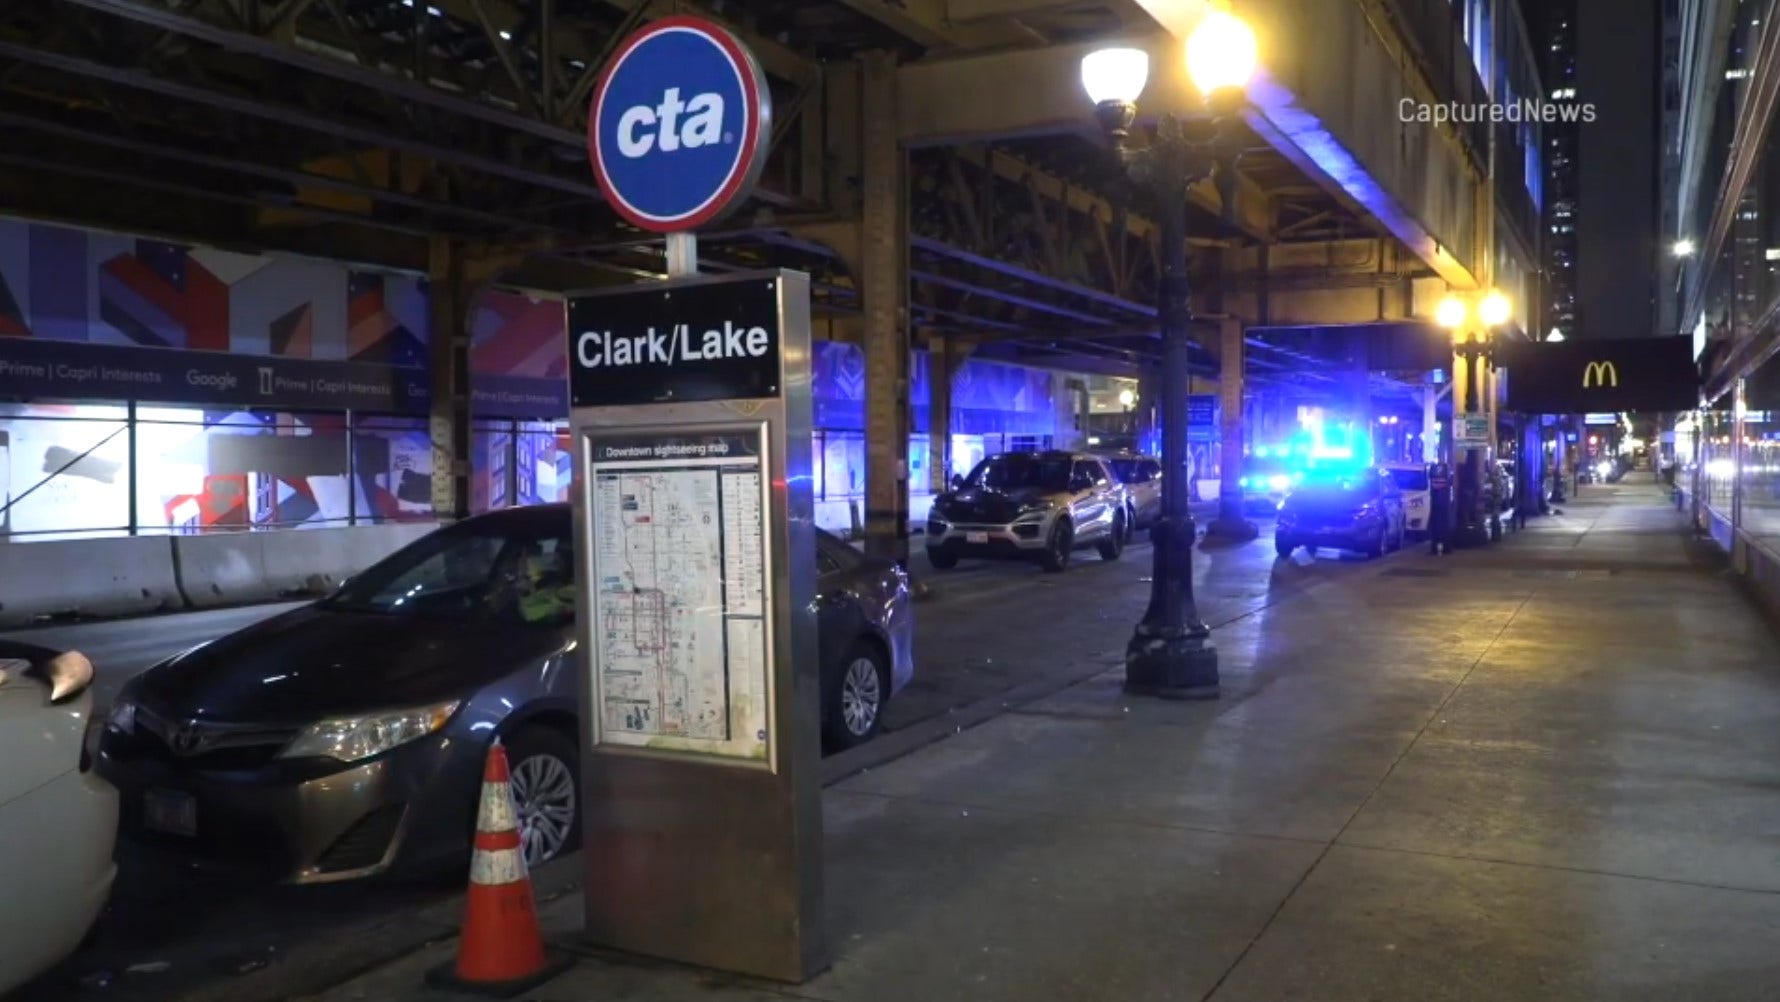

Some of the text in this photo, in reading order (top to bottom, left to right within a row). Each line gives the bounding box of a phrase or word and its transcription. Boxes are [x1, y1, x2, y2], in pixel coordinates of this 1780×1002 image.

[577, 320, 769, 368] Clark/Lake
[0, 360, 45, 377] Prime
[57, 364, 98, 382] Capri
[101, 365, 162, 384] Interests
[186, 369, 238, 391] Google
[274, 376, 308, 390] Prime
[316, 378, 346, 394] Capri
[348, 380, 391, 396] Interests
[606, 442, 729, 458] Downtown sightseeing map
